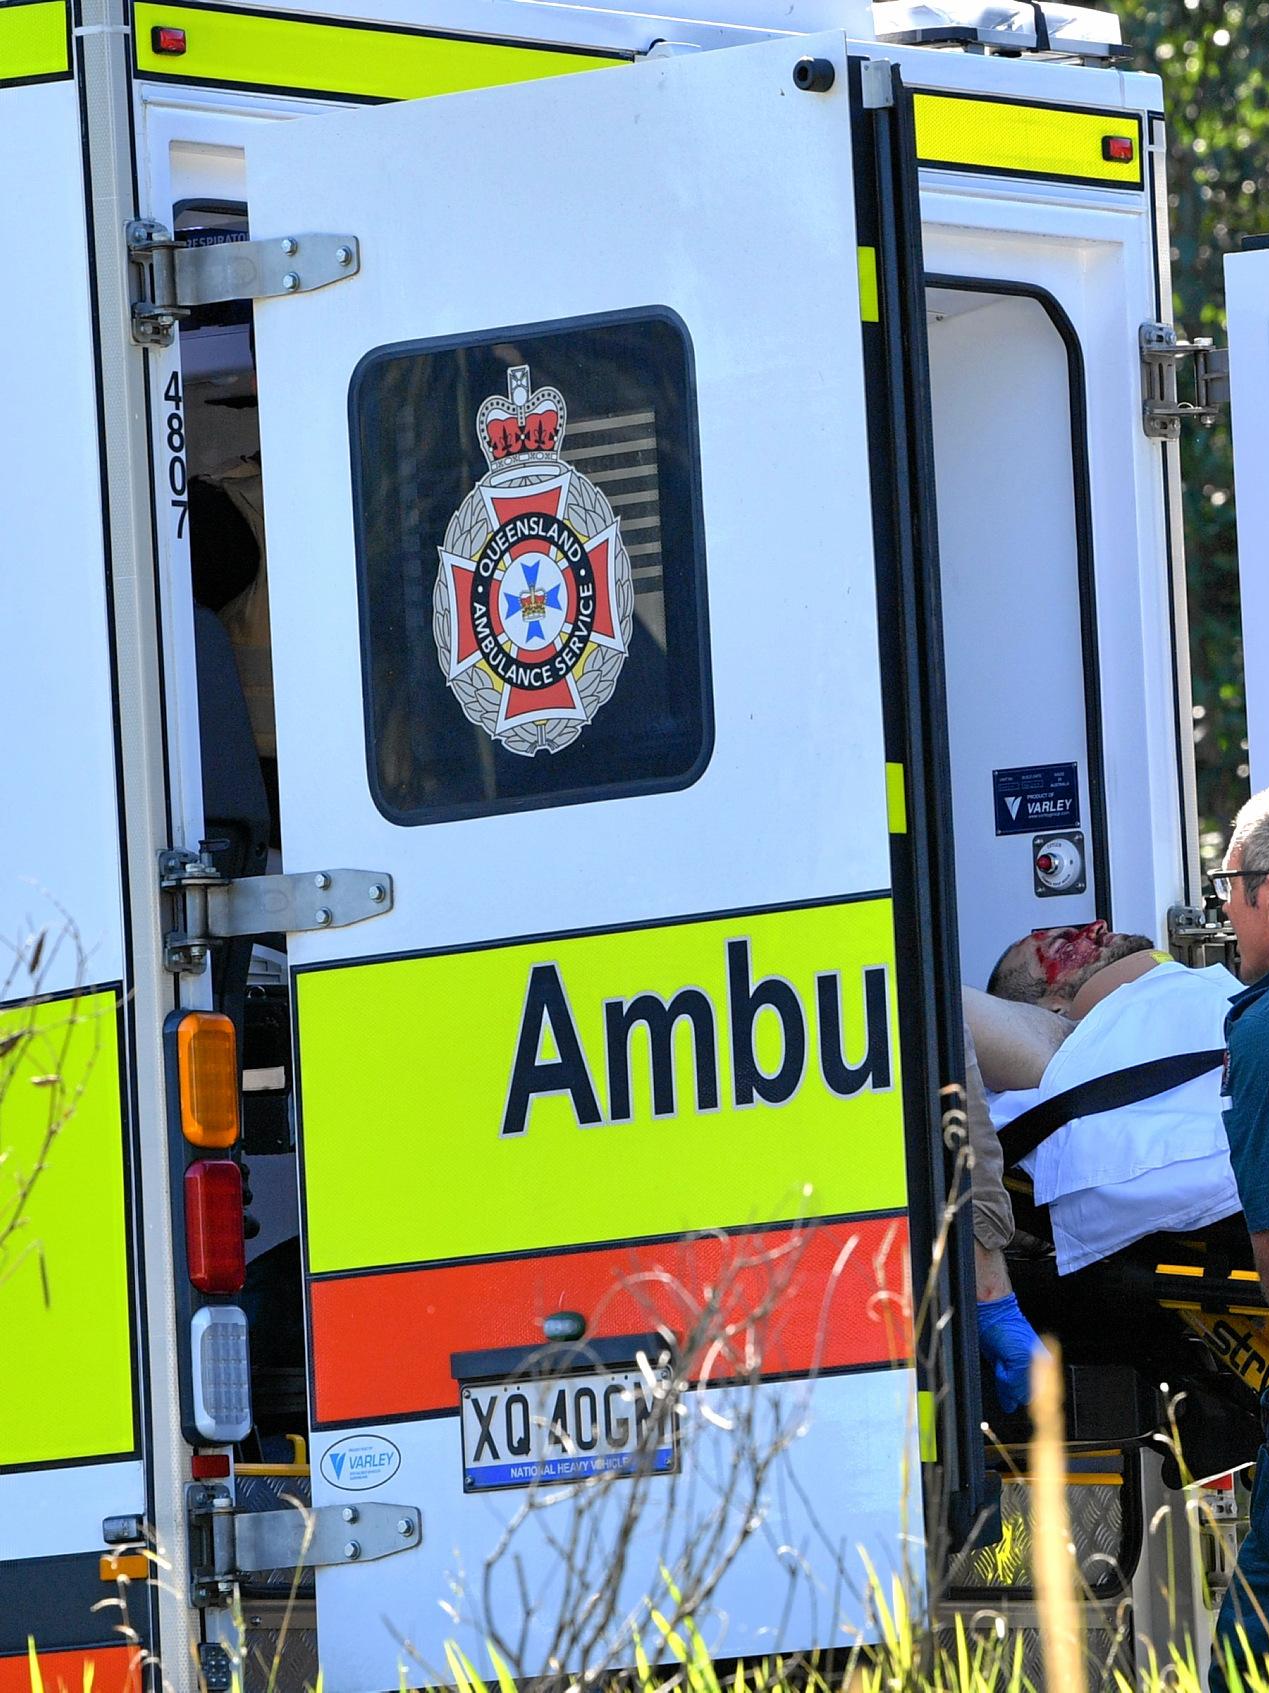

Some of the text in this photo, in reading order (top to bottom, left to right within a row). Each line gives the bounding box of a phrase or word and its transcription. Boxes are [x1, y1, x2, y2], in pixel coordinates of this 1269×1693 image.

[163, 371, 189, 539] 4807
[479, 517, 582, 578] QUEENSLAND
[473, 582, 593, 687] AMBULANCE SERVICE
[1027, 799, 1072, 814] VARLEY
[499, 936, 893, 1138] Ambu
[349, 1452, 394, 1469] VARLEY
